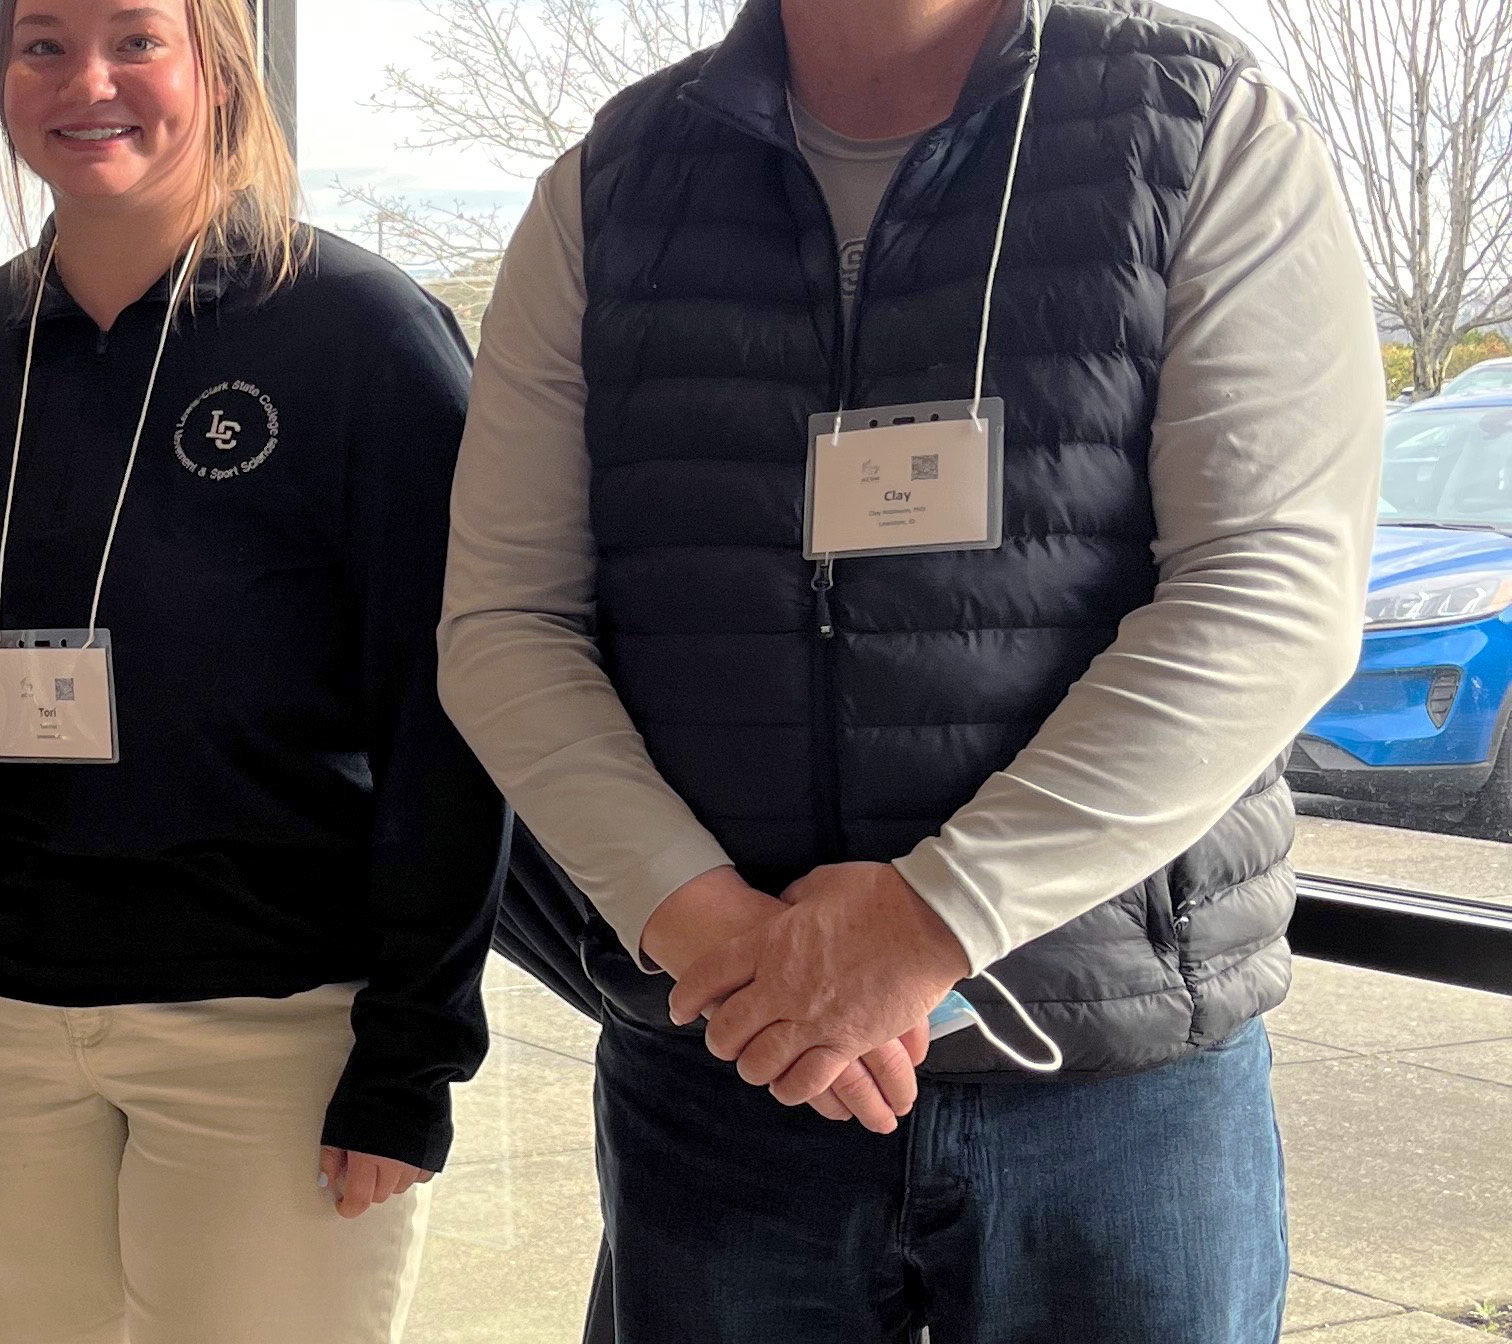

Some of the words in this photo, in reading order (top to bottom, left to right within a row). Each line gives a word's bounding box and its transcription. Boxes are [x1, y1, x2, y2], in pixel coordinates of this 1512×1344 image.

[231, 379, 260, 397] State
[259, 394, 279, 436] College
[209, 466, 240, 481] Sport
[240, 436, 279, 473] Sciences
[883, 490, 911, 503] Clay
[38, 707, 57, 718] Tori
